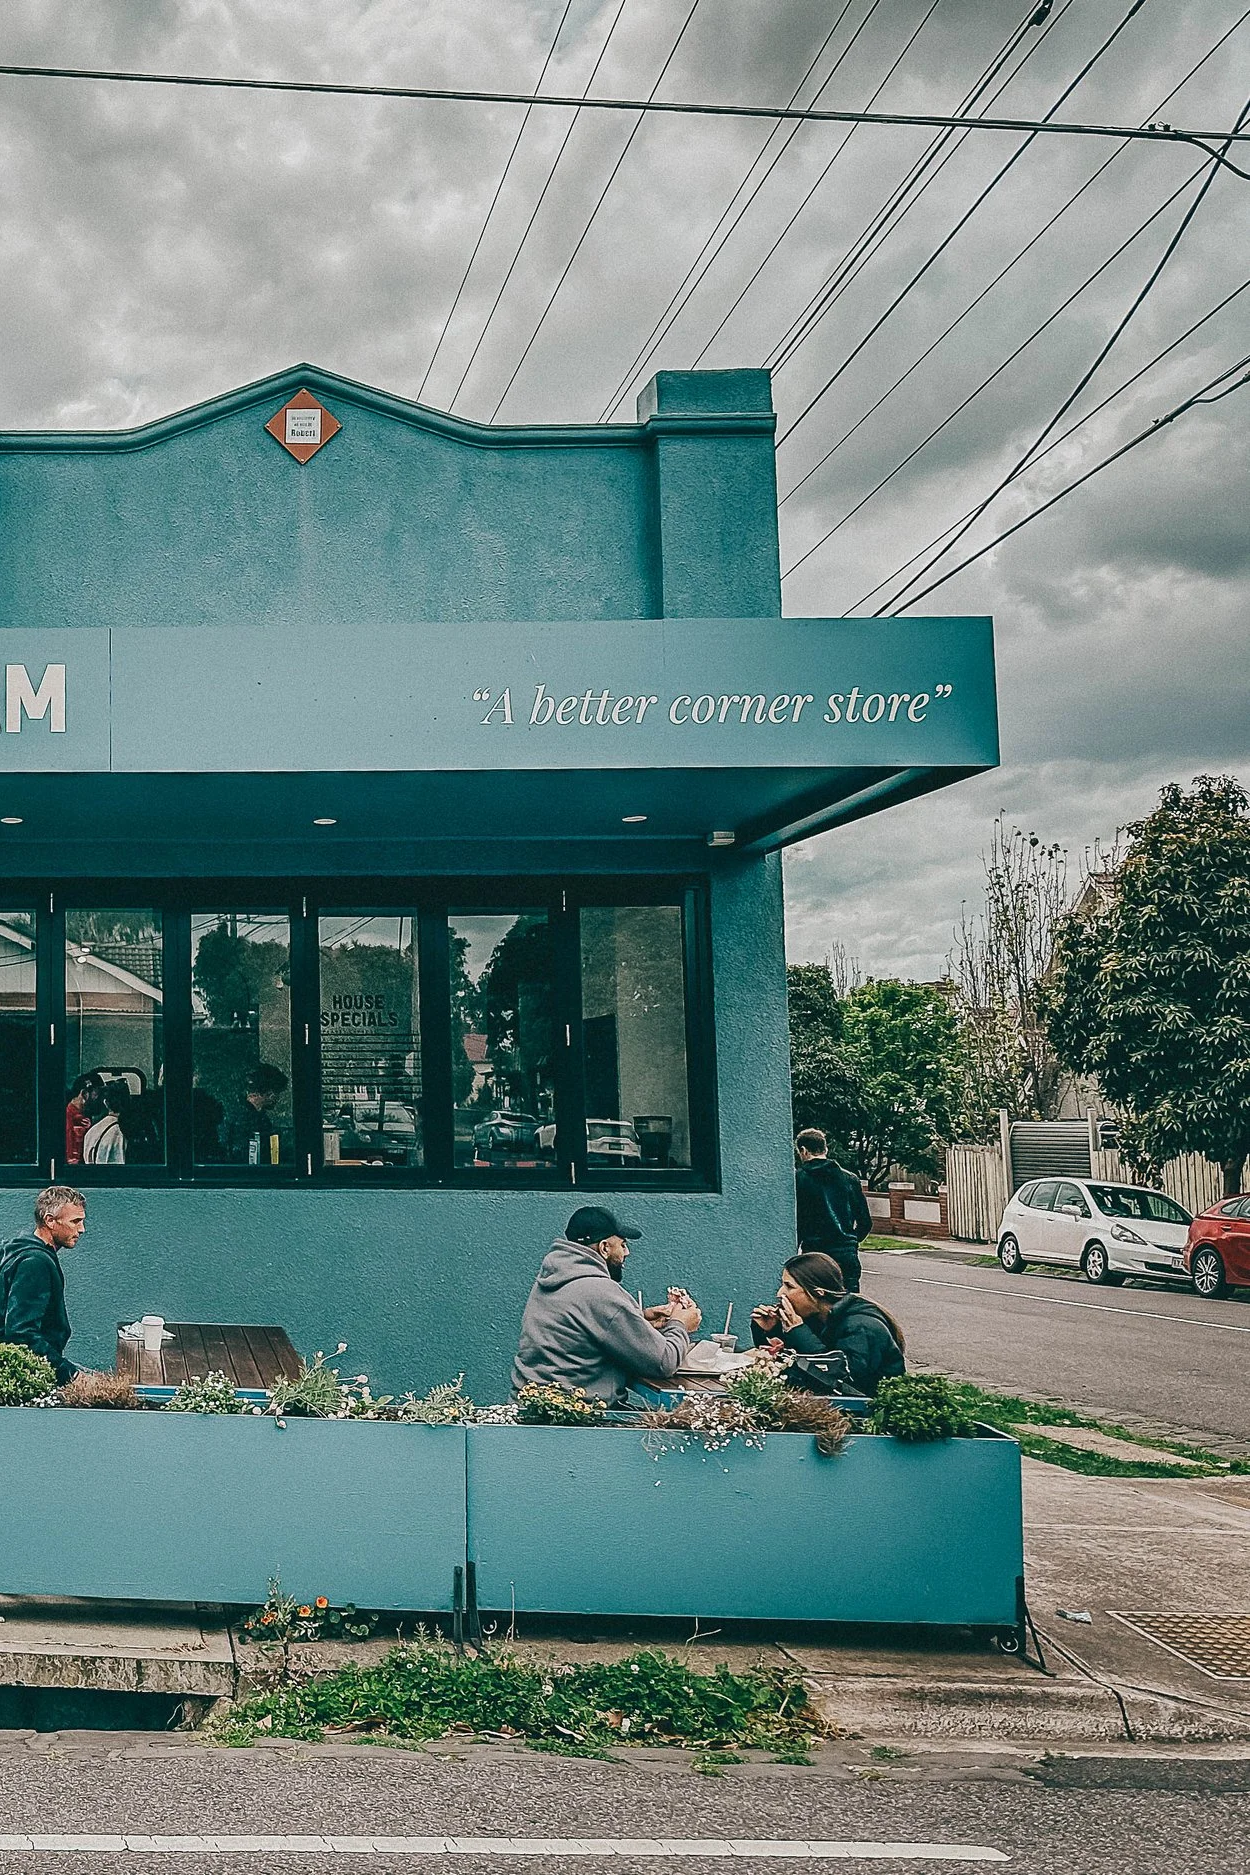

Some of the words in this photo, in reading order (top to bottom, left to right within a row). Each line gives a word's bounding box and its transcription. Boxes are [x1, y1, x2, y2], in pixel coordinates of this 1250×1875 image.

[528, 684, 659, 726] better
[667, 690, 816, 725] corner
[332, 994, 385, 1010] HOUSE
[320, 1011, 399, 1027] SPECIALS
